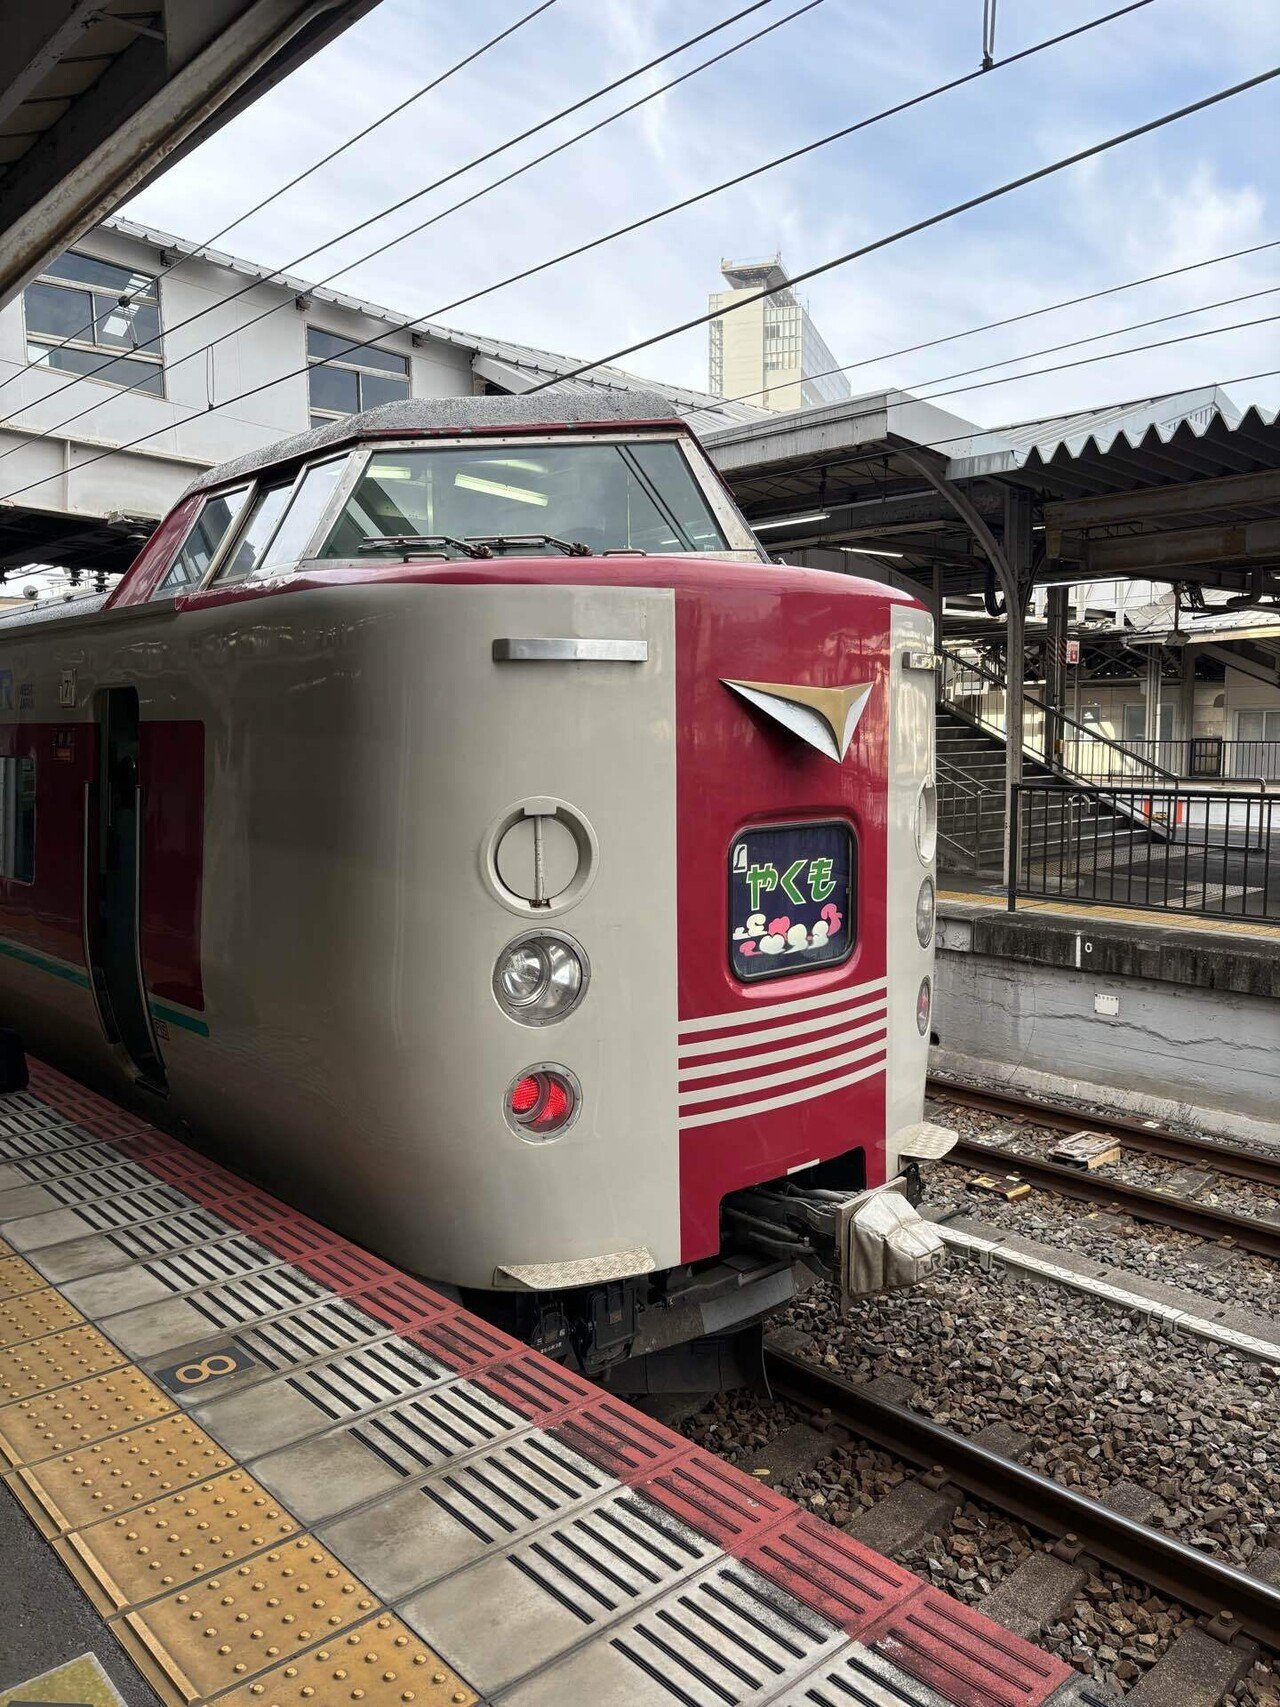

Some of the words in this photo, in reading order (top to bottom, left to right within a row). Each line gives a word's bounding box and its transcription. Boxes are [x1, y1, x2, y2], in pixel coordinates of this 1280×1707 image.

[64, 679, 72, 698] 7
[745, 857, 837, 911] やくも
[920, 1253, 941, 1273] JR
[175, 1355, 237, 1384] 8
